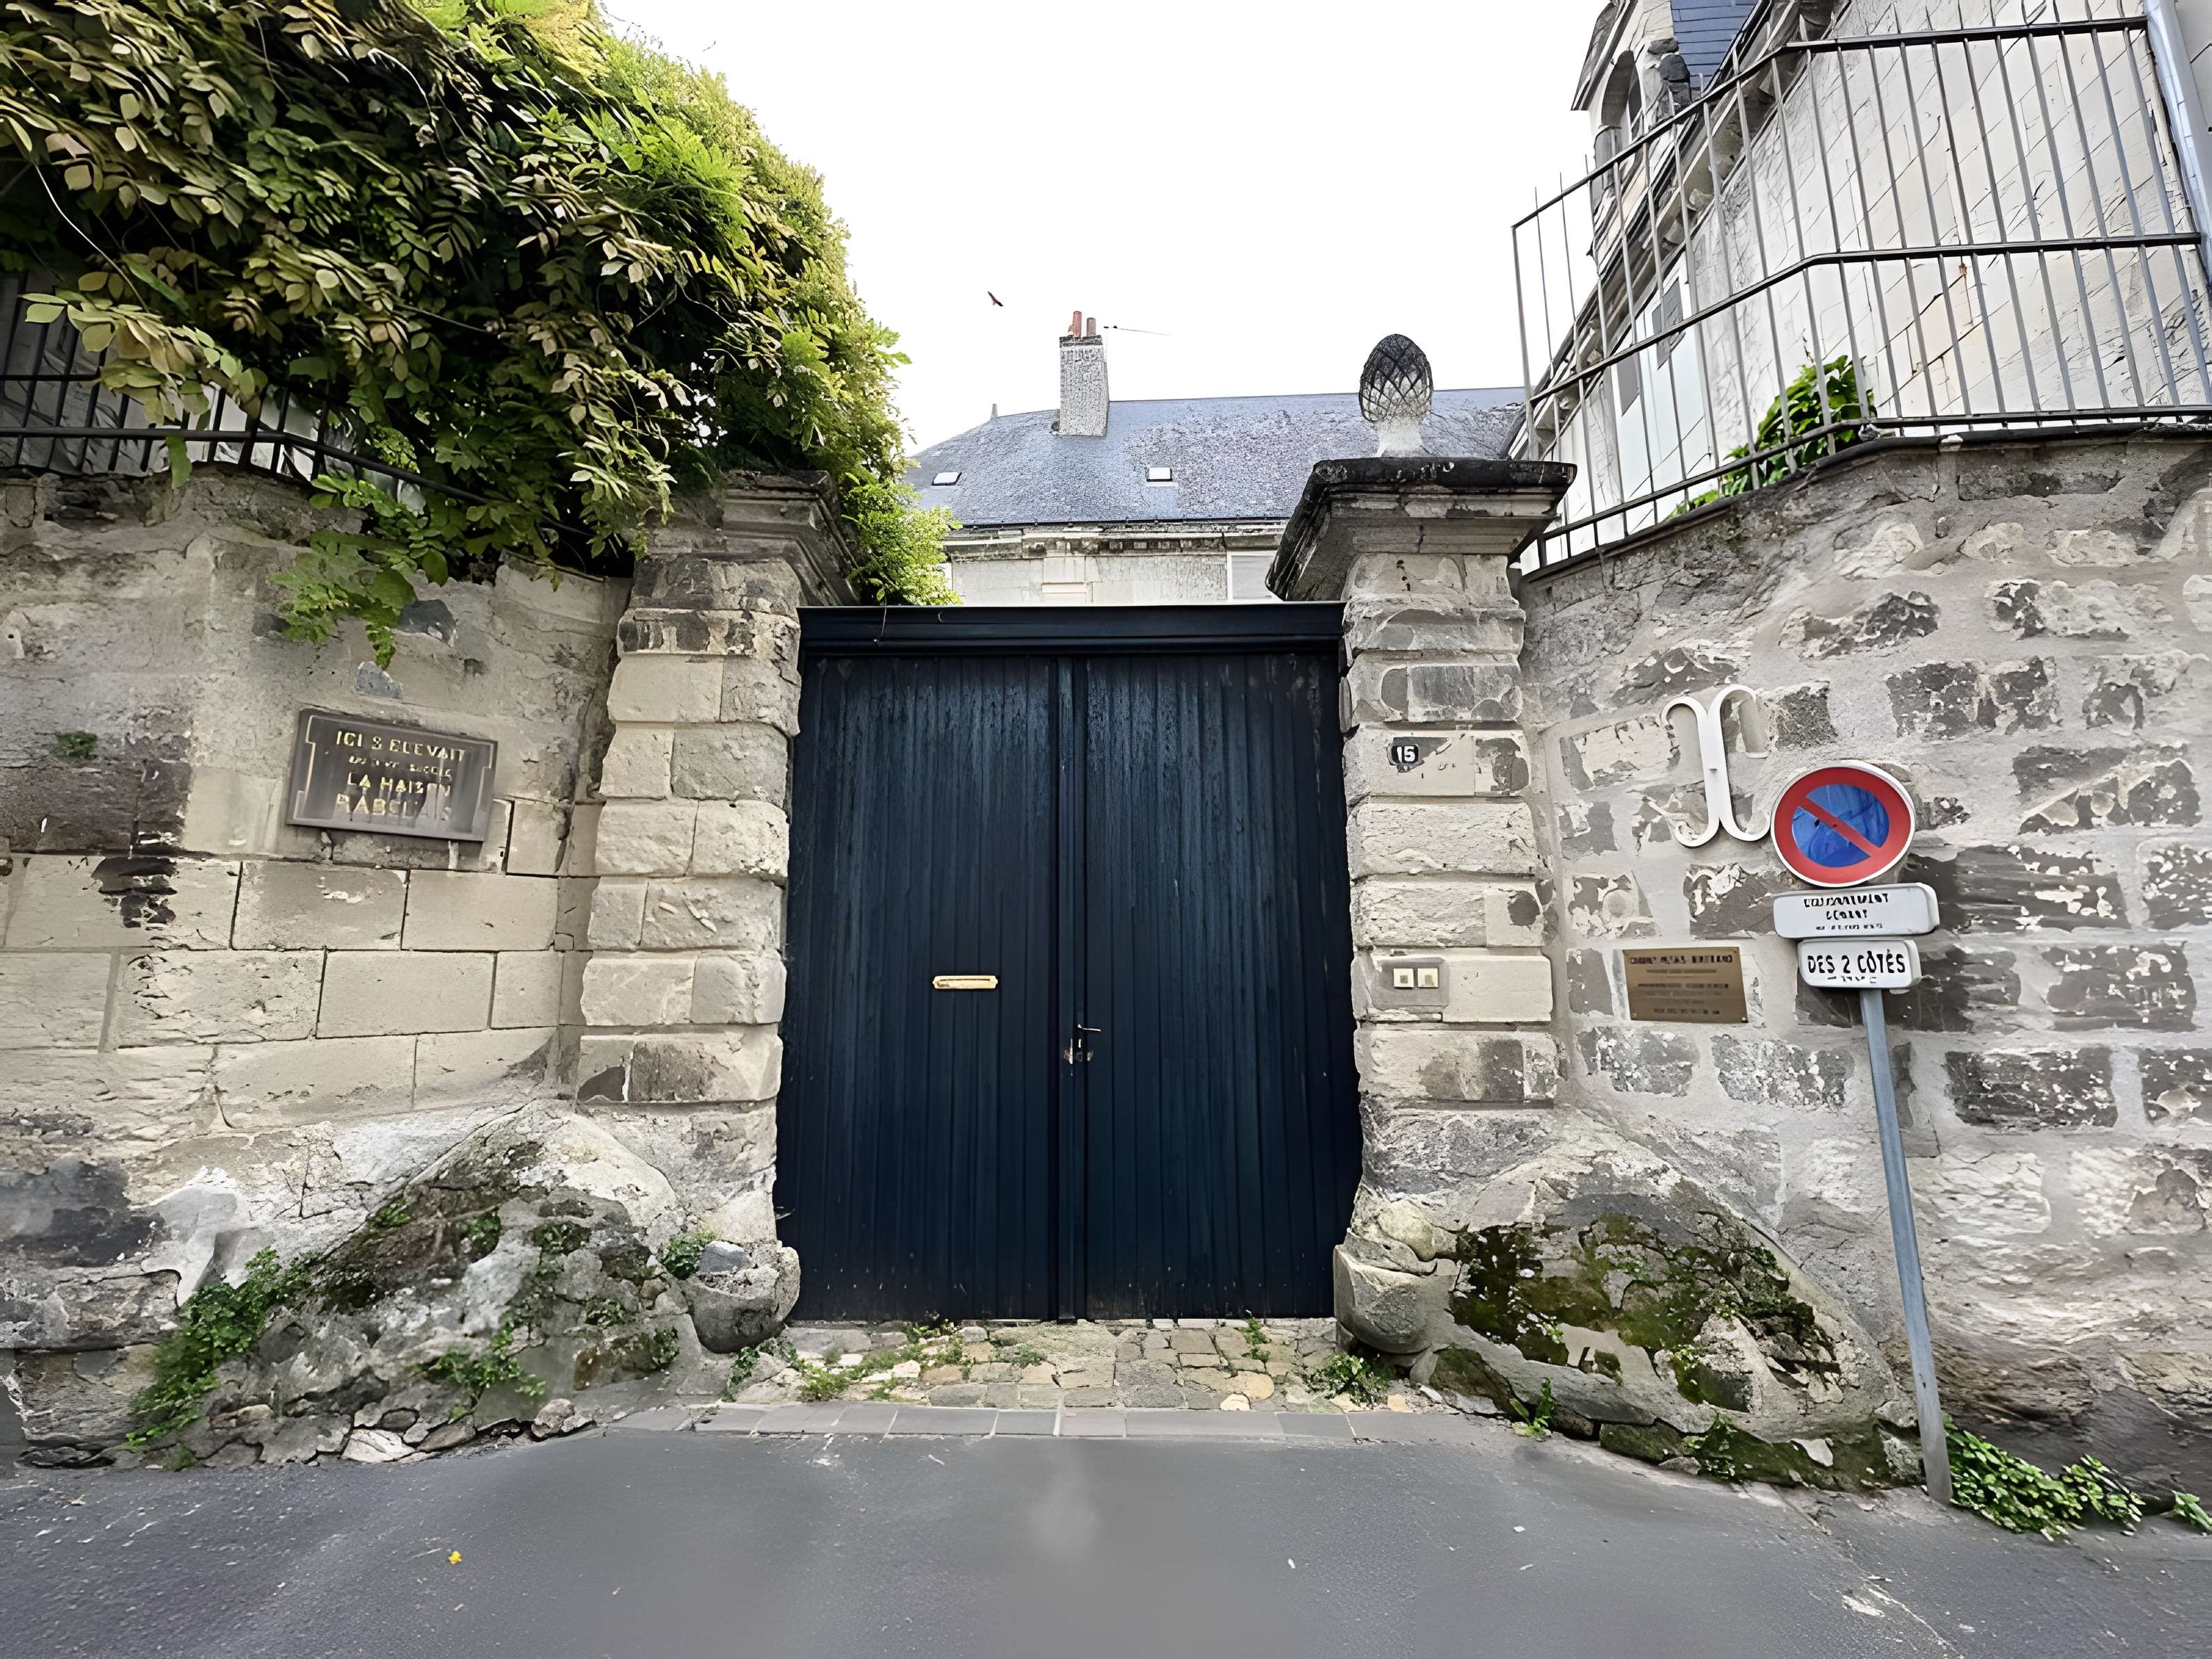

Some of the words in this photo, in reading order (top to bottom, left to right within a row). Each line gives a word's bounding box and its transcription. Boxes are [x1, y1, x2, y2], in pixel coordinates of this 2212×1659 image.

[335, 730, 363, 747] ICI
[1396, 745, 1416, 763] 15
[1807, 954, 1835, 974] DES
[1840, 954, 1851, 974] 2
